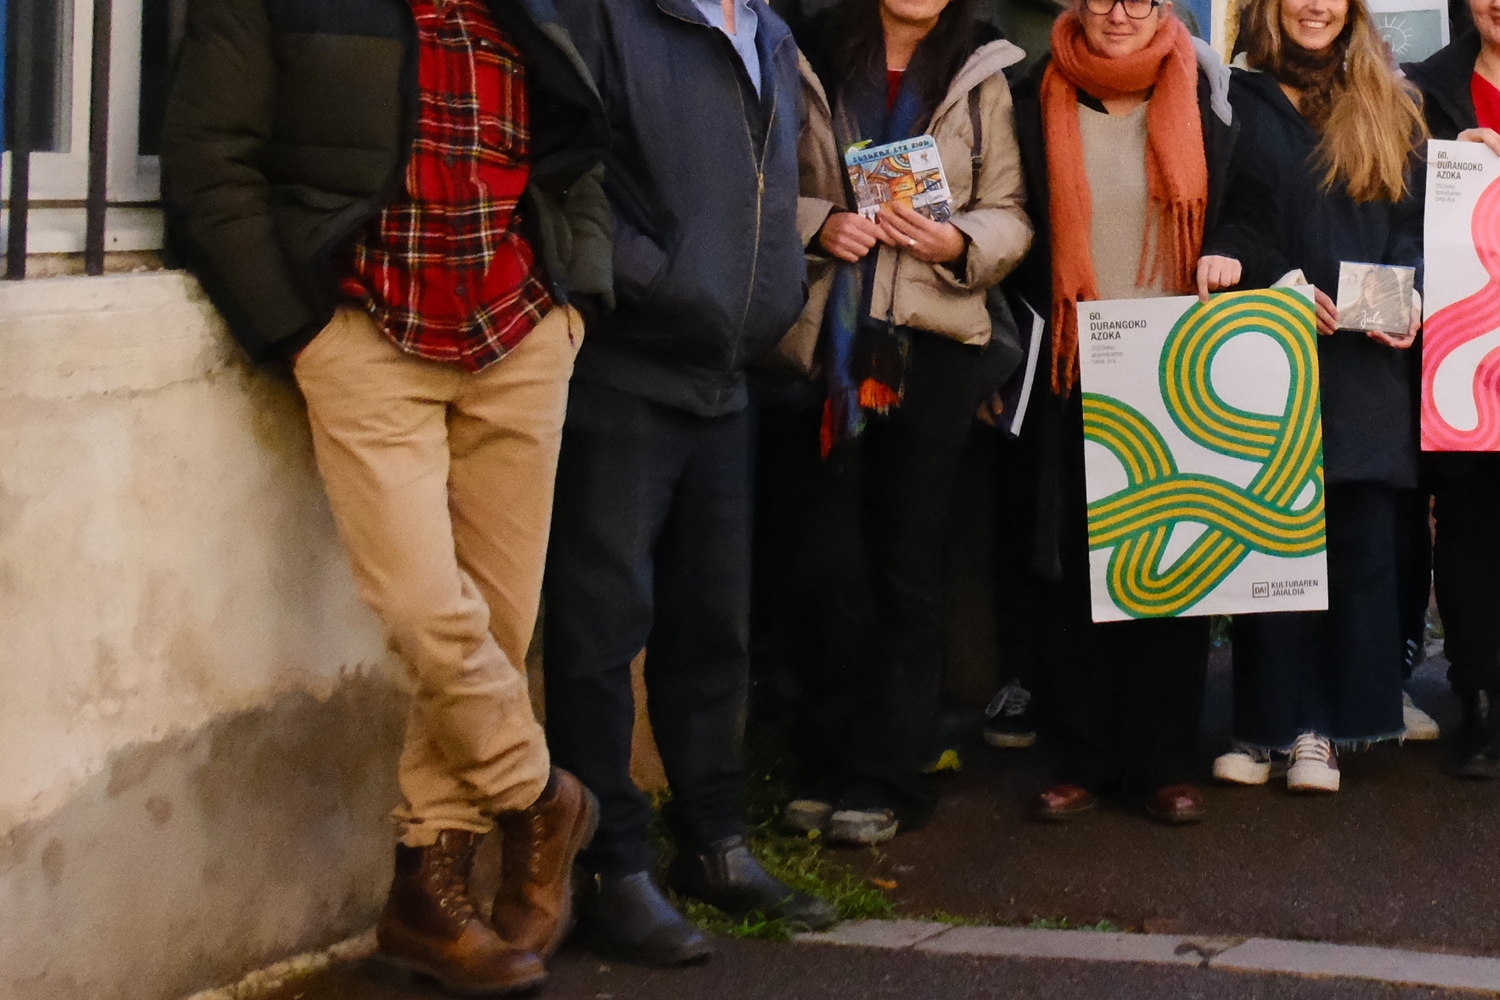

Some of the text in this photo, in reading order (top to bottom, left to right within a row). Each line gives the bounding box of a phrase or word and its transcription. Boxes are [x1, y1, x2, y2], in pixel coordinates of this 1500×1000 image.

[1437, 161, 1483, 172] DURANGOKO
[1436, 170, 1461, 180] AZOKA
[1090, 319, 1147, 331] DURANGOKO
[1090, 331, 1121, 341] AZOKA
